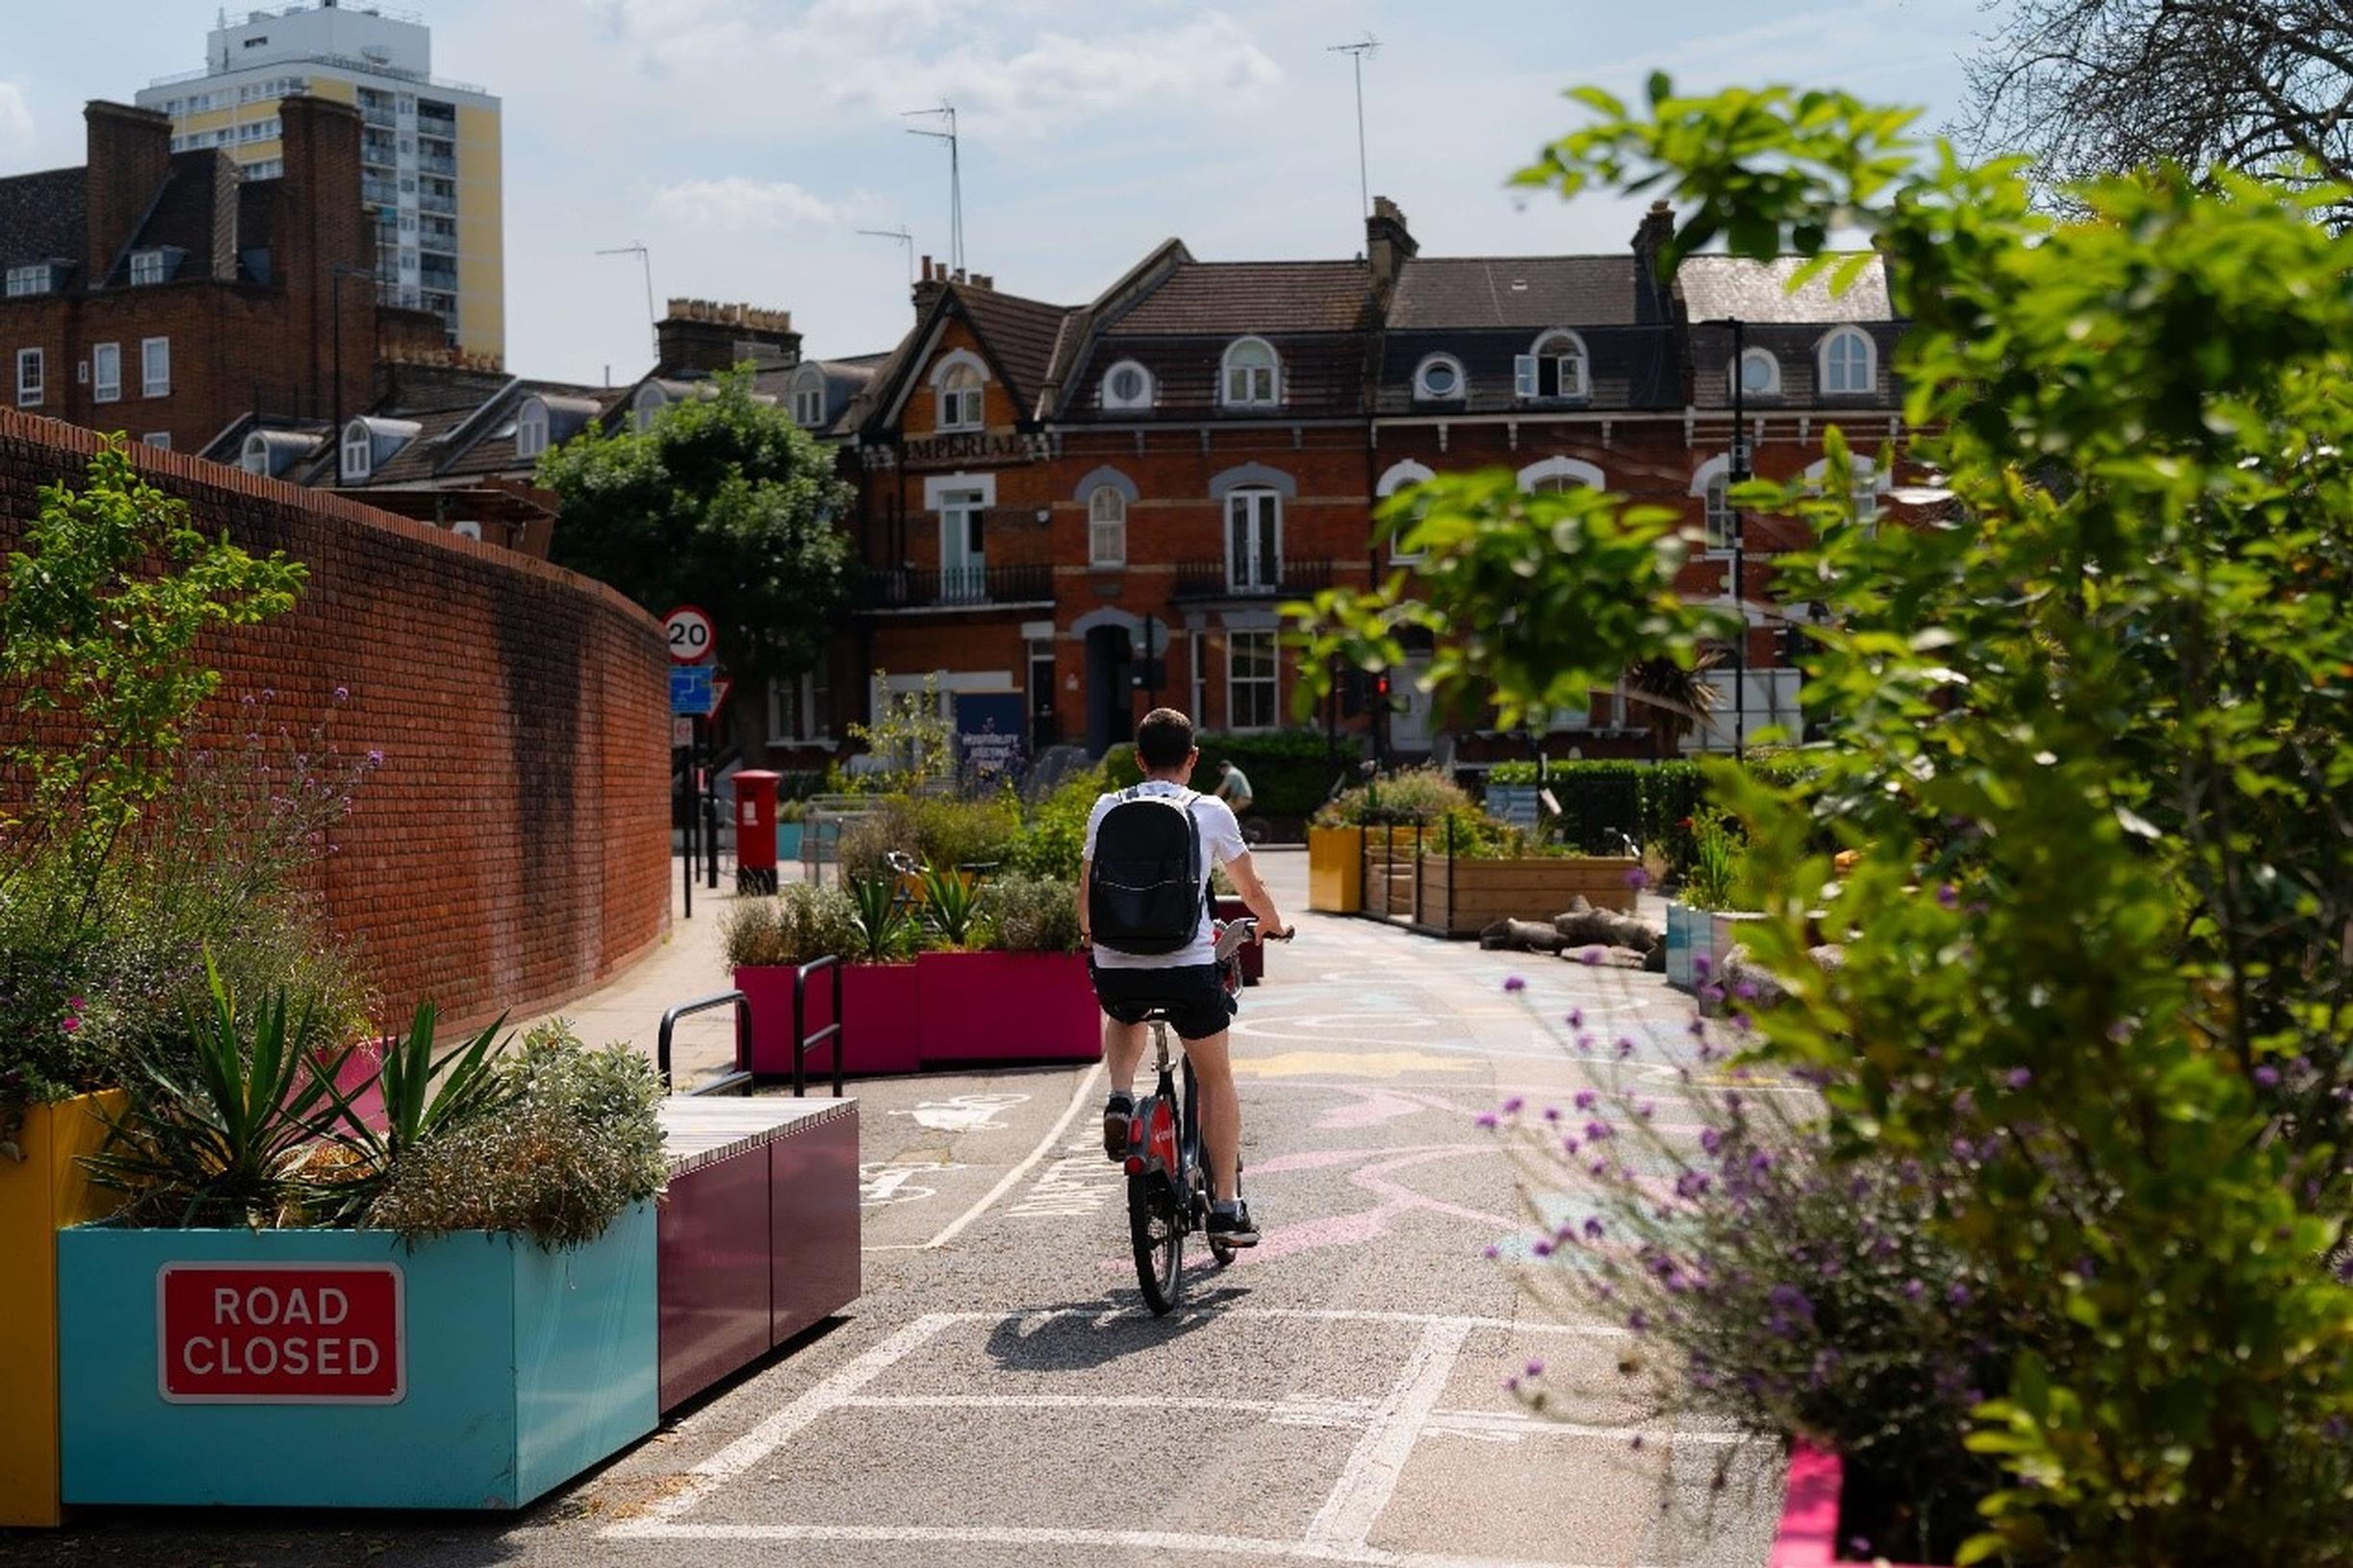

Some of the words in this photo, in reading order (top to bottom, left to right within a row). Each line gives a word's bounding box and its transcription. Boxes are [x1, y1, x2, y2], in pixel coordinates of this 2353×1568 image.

[670, 623, 707, 646] 20
[213, 1286, 349, 1325] ROAD
[183, 1335, 380, 1375] CLOSED
